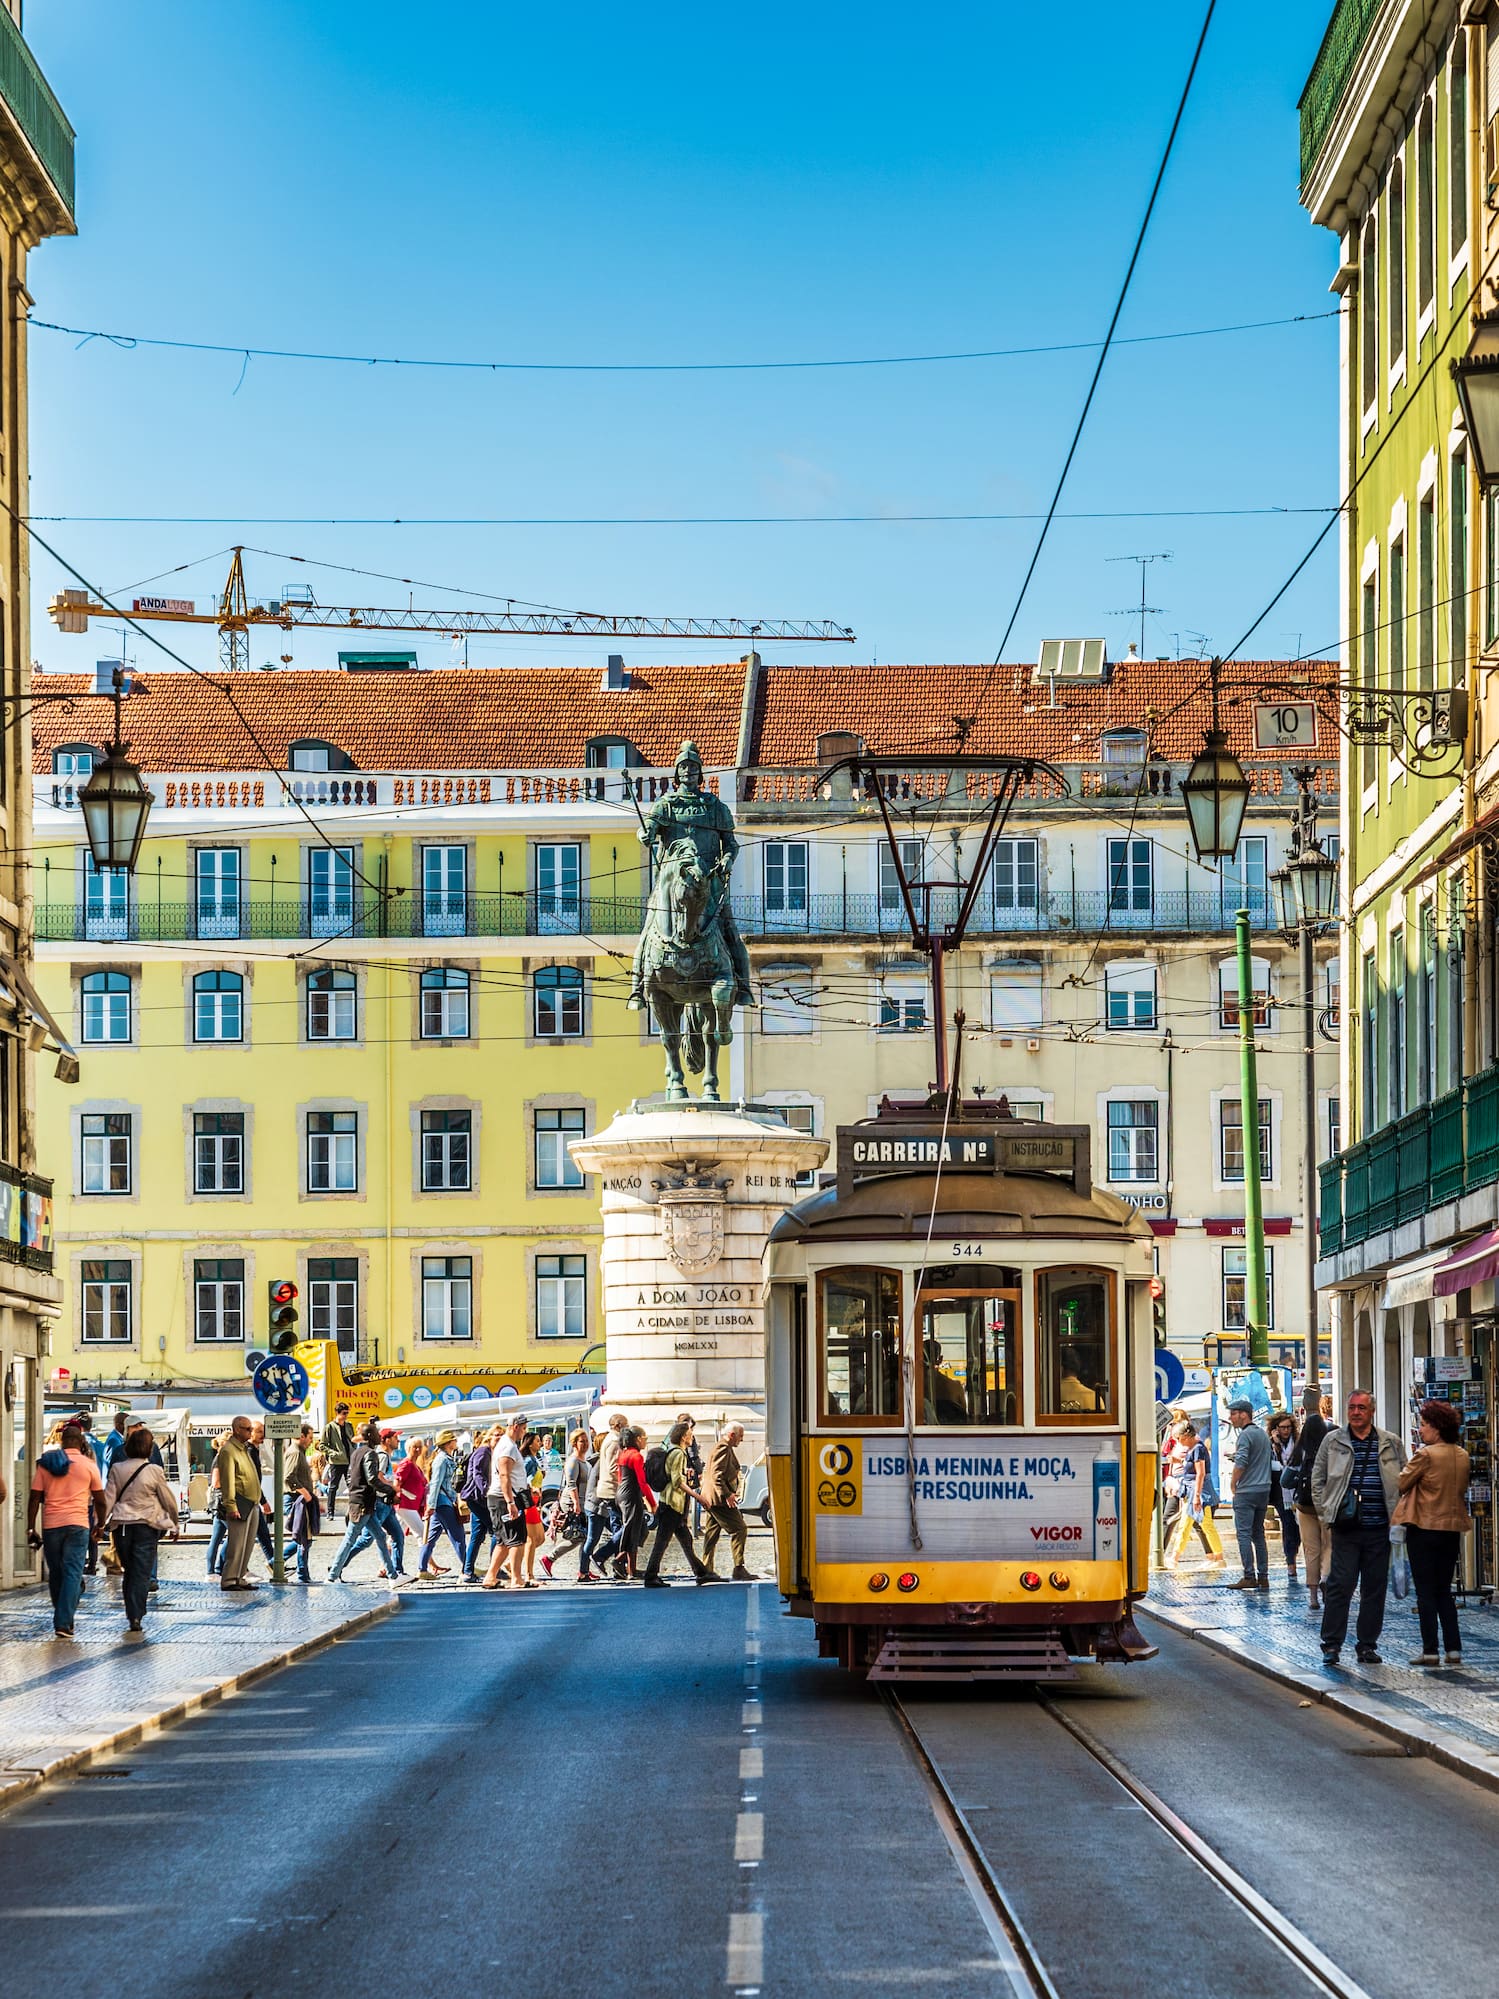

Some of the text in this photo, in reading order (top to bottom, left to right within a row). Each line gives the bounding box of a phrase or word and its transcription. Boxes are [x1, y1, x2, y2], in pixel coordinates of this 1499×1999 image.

[1271, 708, 1299, 733] 10
[1275, 735, 1297, 745] Km/h
[853, 1141, 987, 1162] CARREIRA Nº
[1011, 1142, 1063, 1157] INSTRUÇÃO
[745, 1175, 763, 1187] REI
[770, 1176, 782, 1188] DE
[952, 1243, 983, 1257] 544
[637, 1291, 646, 1304] A
[653, 1290, 687, 1304] DOM
[749, 1289, 754, 1302] I
[637, 1315, 754, 1328] A CIDADE DE LISBOA
[674, 1341, 718, 1352] MCMLXXI
[336, 1389, 358, 1398] This
[360, 1389, 379, 1399] city
[868, 1457, 1076, 1482] LISBOA MENINA E MOÇA,
[914, 1481, 1034, 1501] FRESQUINHA.
[1096, 1518, 1117, 1526] VIGOR
[1030, 1526, 1082, 1541] VIGOR
